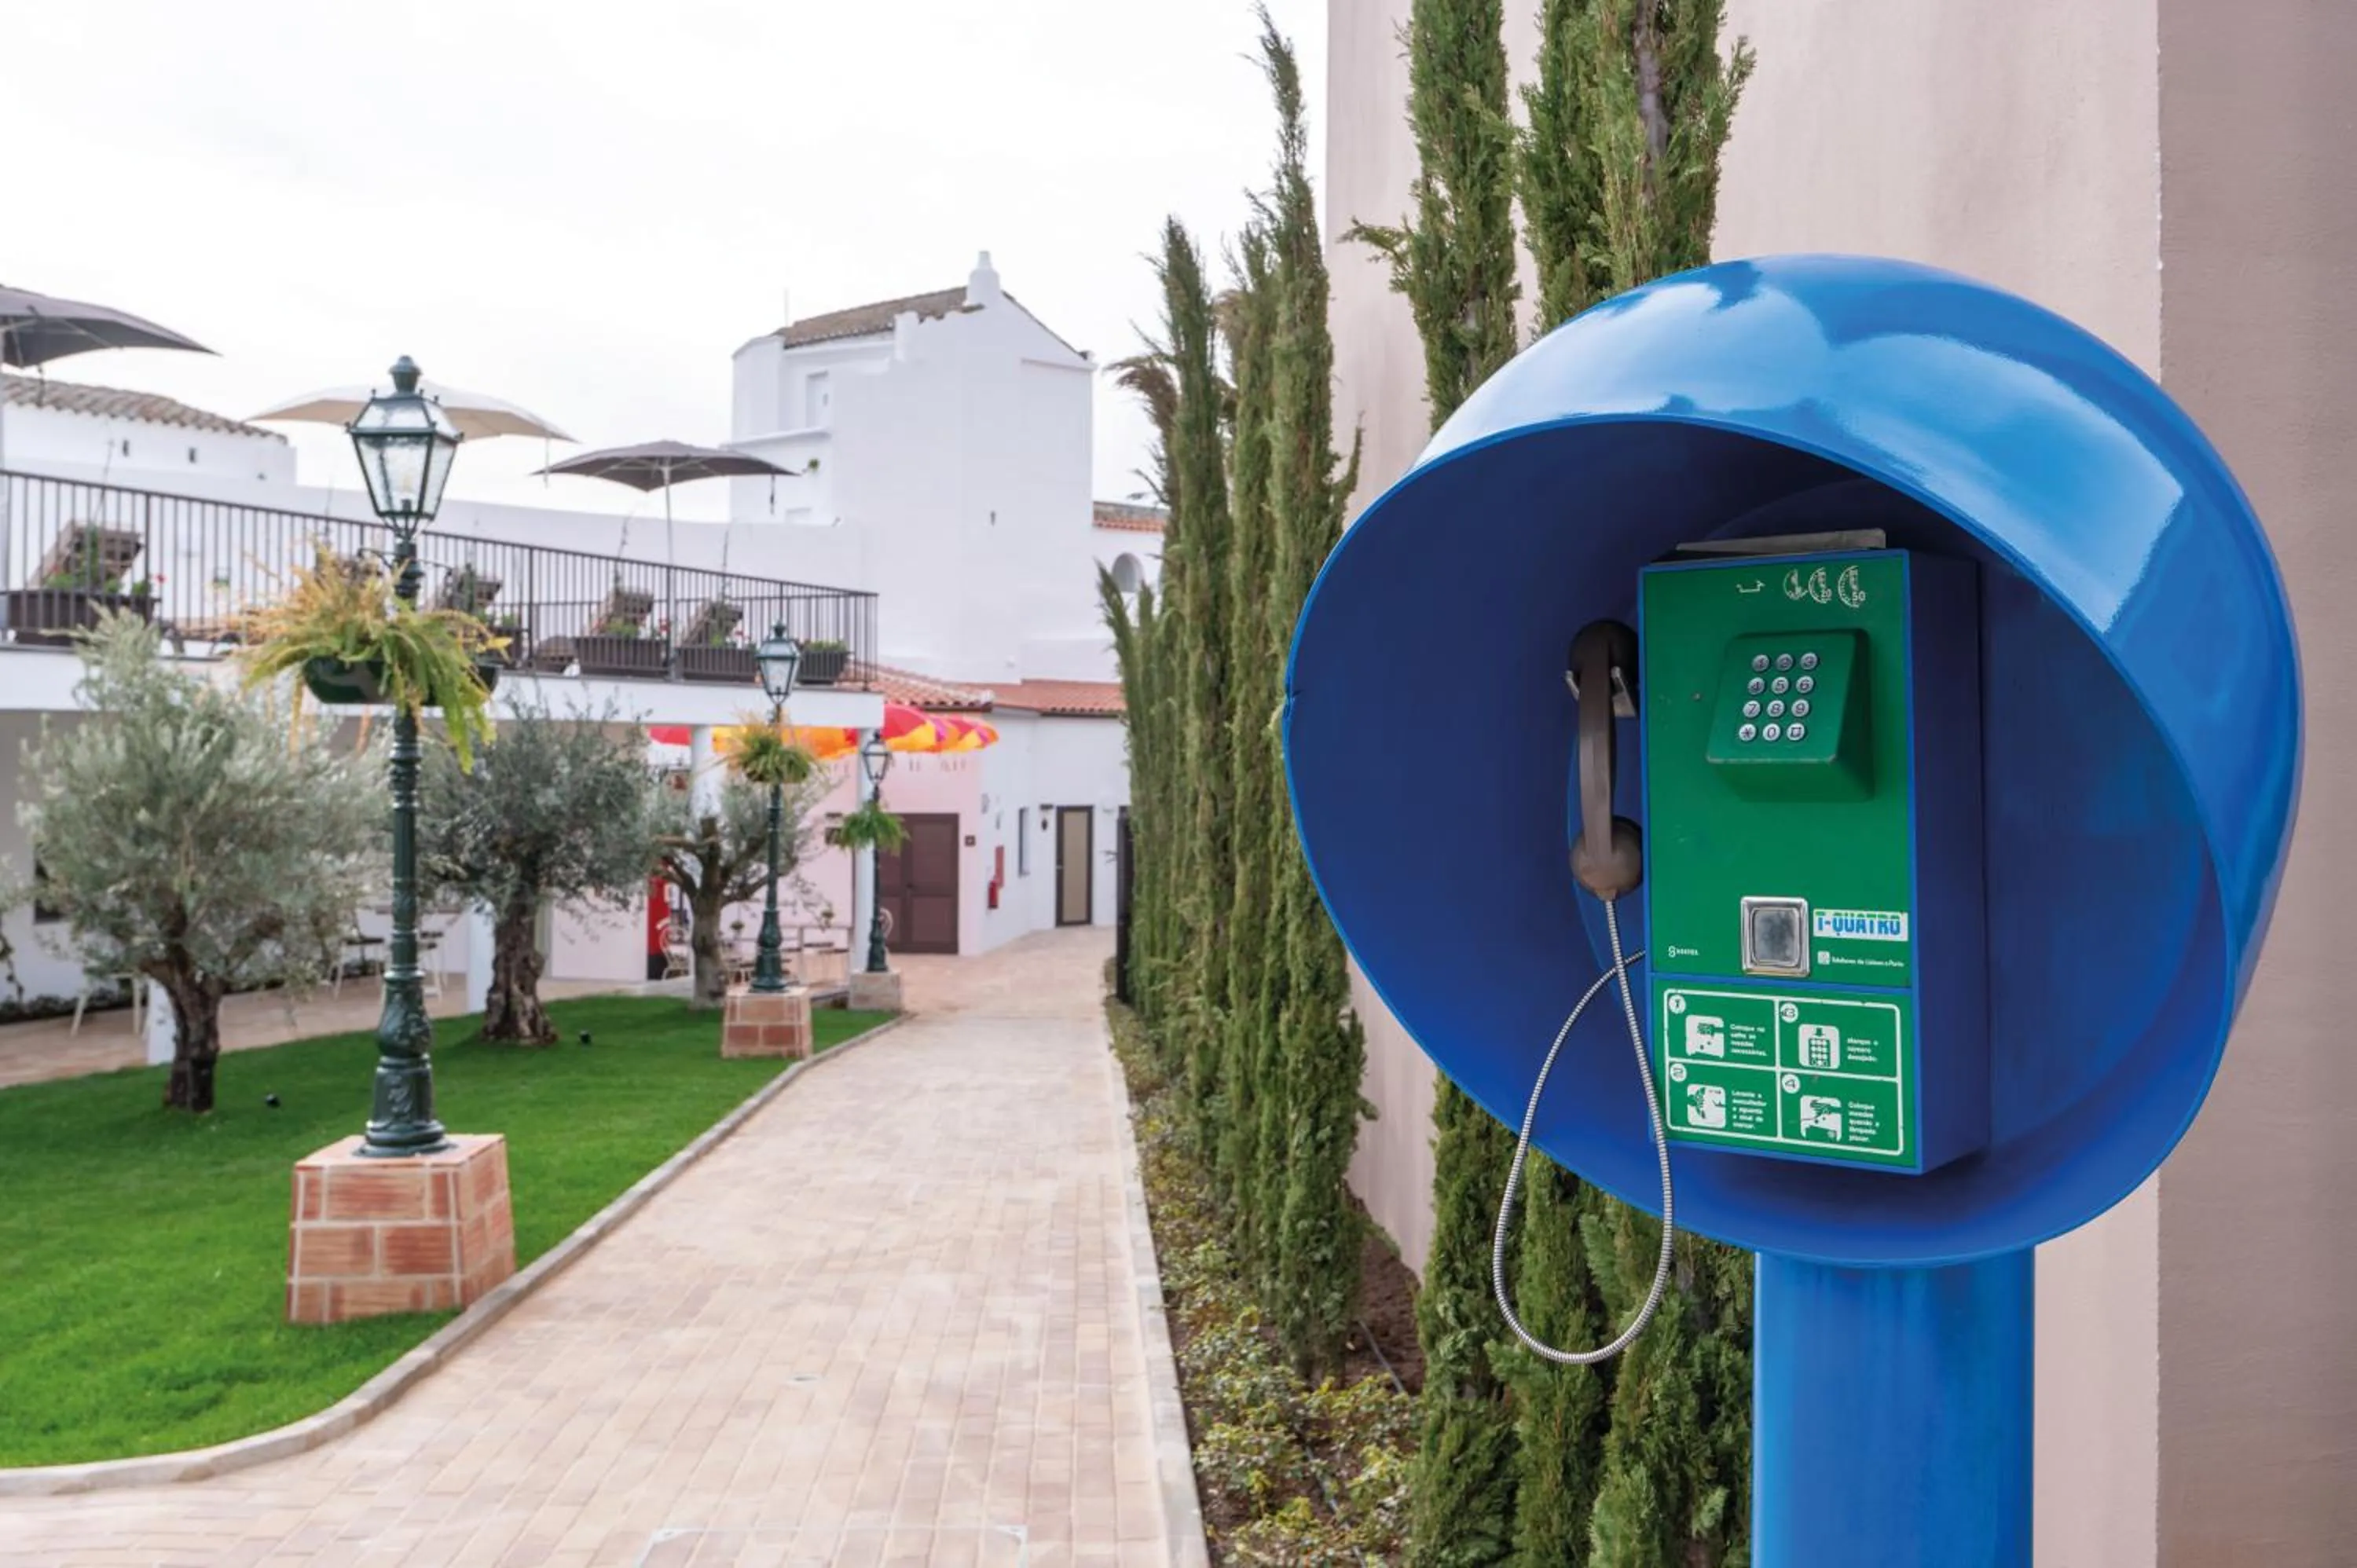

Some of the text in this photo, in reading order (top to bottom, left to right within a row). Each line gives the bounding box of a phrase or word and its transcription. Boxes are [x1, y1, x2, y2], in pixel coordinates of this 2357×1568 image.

[1853, 591, 1866, 602] 50
[1803, 655, 1815, 668] 3
[1750, 679, 1810, 692] 4 5 6
[1747, 702, 1806, 716] 7 8 9
[1766, 726, 1777, 739] 0
[1815, 910, 1901, 937] T-QUATRO
